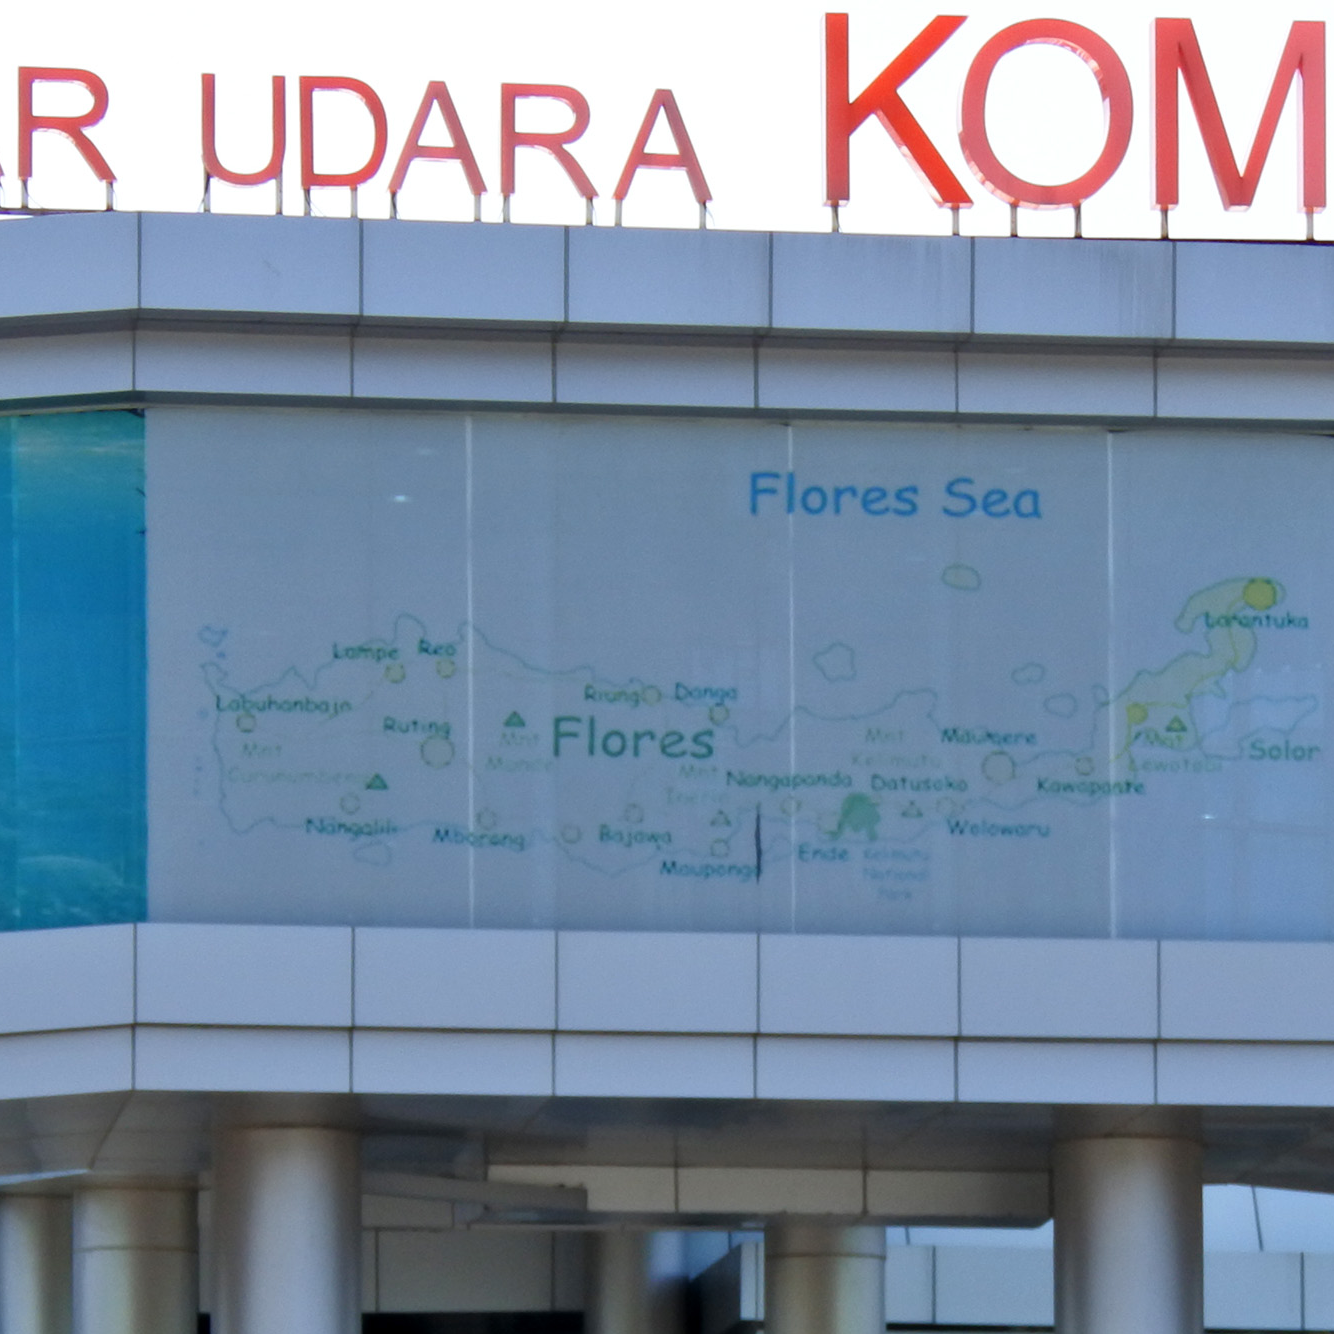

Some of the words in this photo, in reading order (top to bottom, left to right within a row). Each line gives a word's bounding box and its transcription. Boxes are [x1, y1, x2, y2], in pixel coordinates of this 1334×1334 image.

[202, 73, 713, 203] UDARA
[749, 471, 919, 517] Flores
[942, 477, 1042, 519] Sea
[1204, 612, 1309, 629] Larantuka
[674, 682, 737, 706] Danga
[552, 715, 715, 759] Flores
[1248, 739, 1321, 761] Solor
[798, 843, 850, 862] Ende
